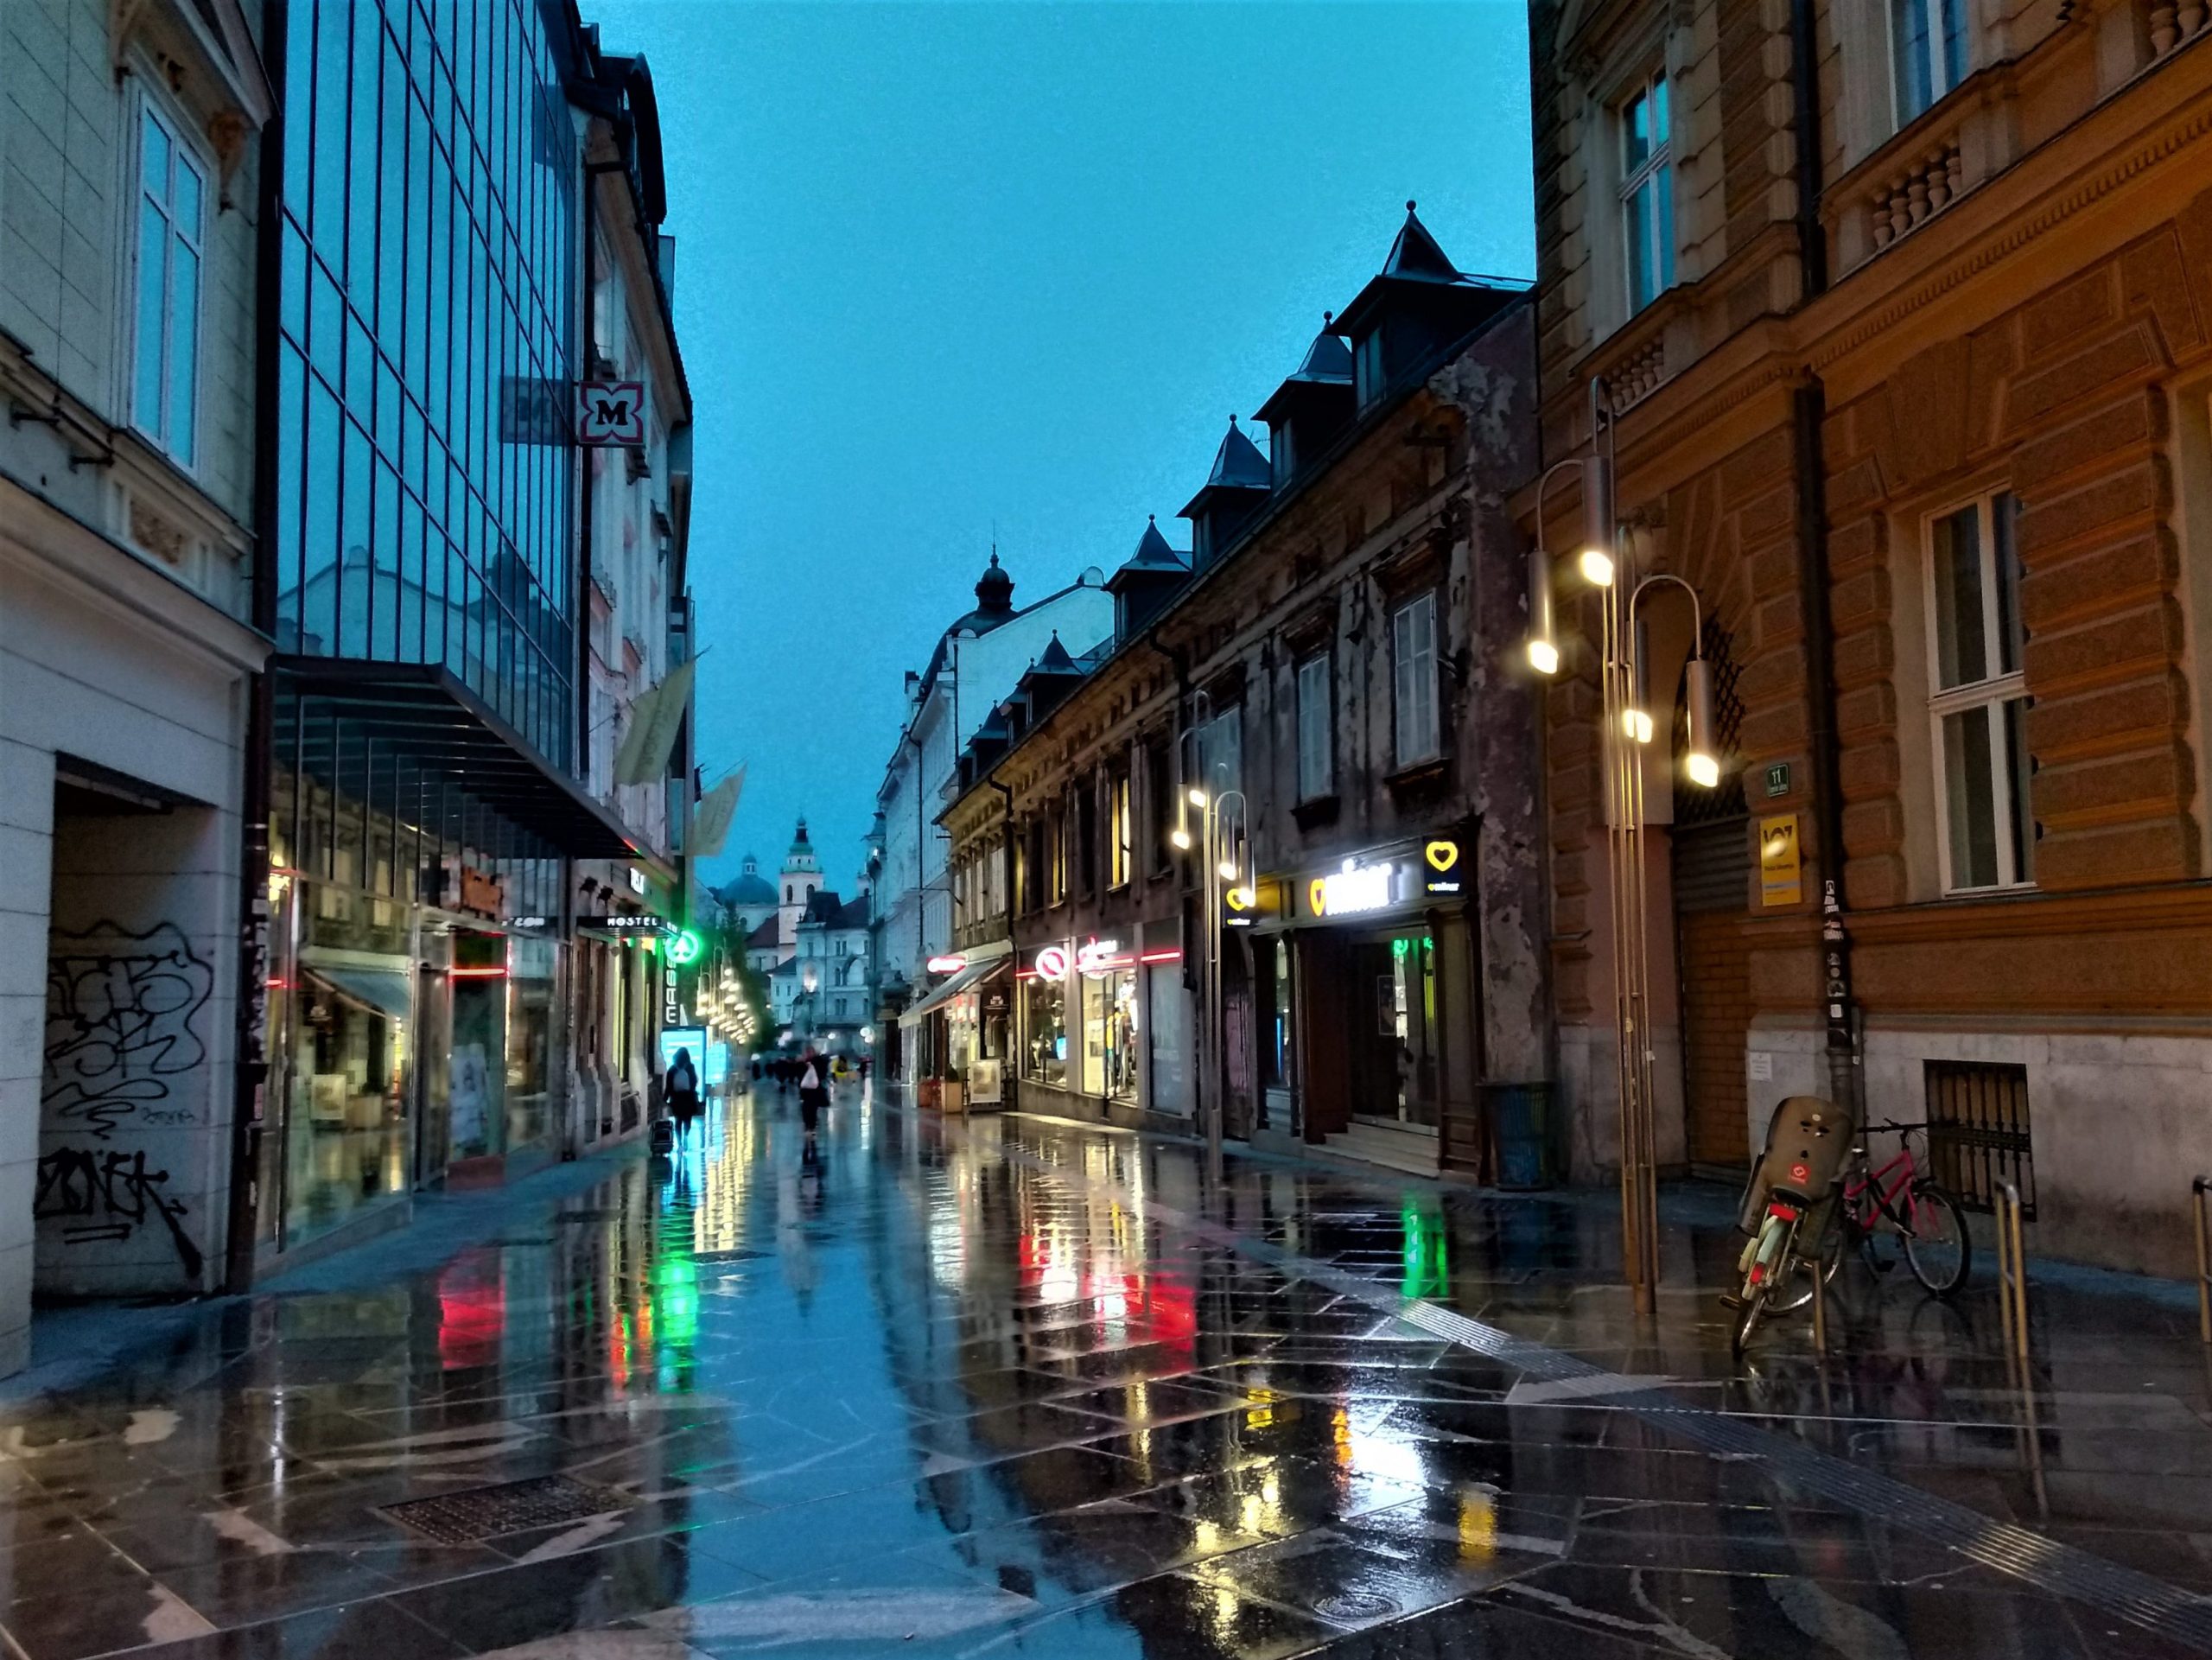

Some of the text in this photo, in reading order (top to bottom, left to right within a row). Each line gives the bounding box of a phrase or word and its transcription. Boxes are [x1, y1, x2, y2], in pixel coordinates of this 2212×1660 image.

[595, 399, 629, 425] M
[1771, 768, 1781, 785] 11
[607, 916, 658, 926] HOSTEL
